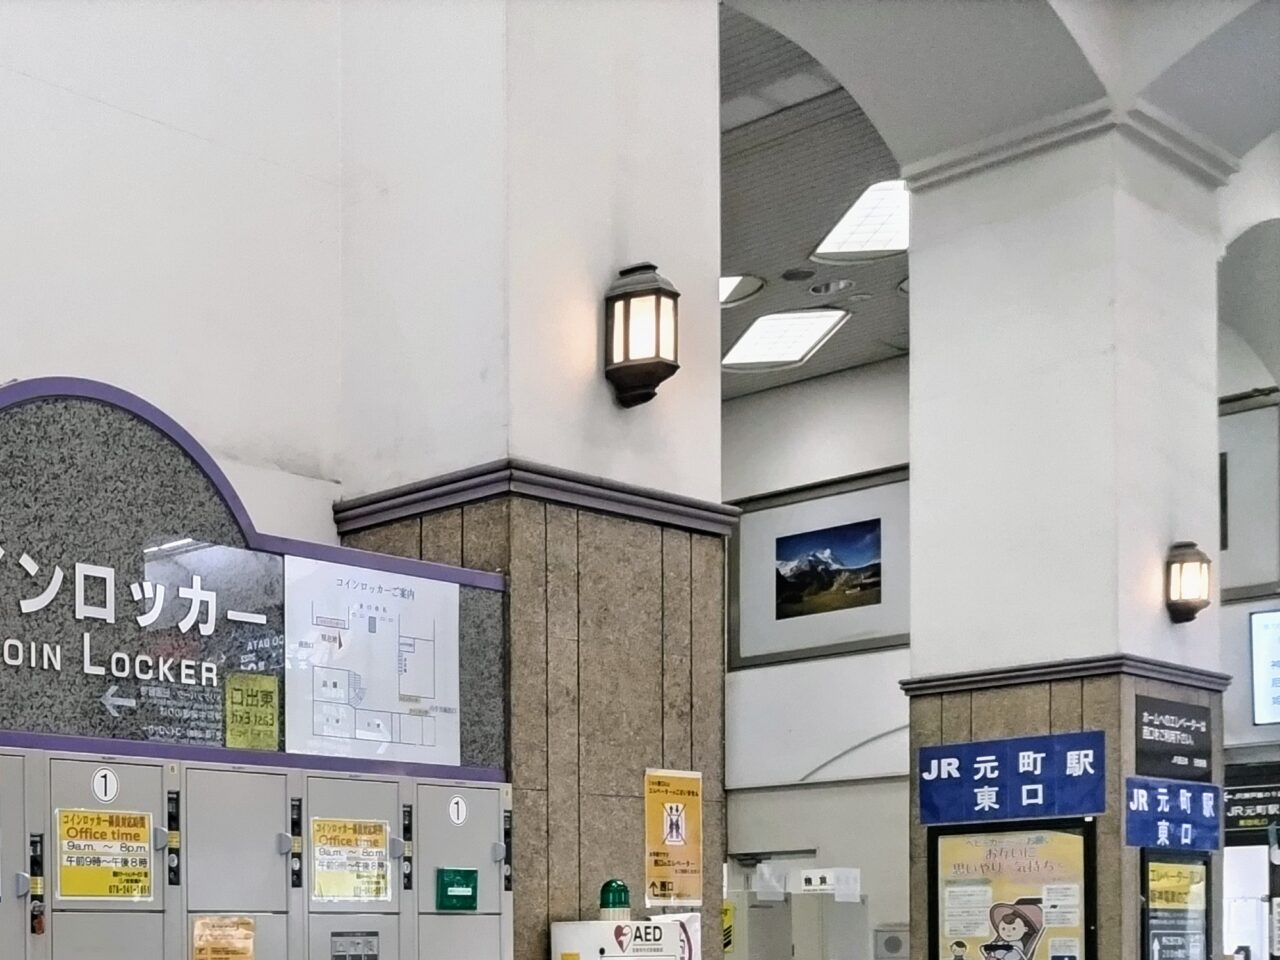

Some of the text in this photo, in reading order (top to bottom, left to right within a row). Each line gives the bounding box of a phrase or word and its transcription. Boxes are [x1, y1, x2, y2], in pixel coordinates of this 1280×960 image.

[336, 578, 415, 600] コインロッカーご案内
[3, 638, 61, 671] OIN
[973, 784, 1044, 812] 東口
[66, 827, 140, 841] Office time
[1157, 820, 1192, 846] 東口
[633, 925, 663, 943] AED
